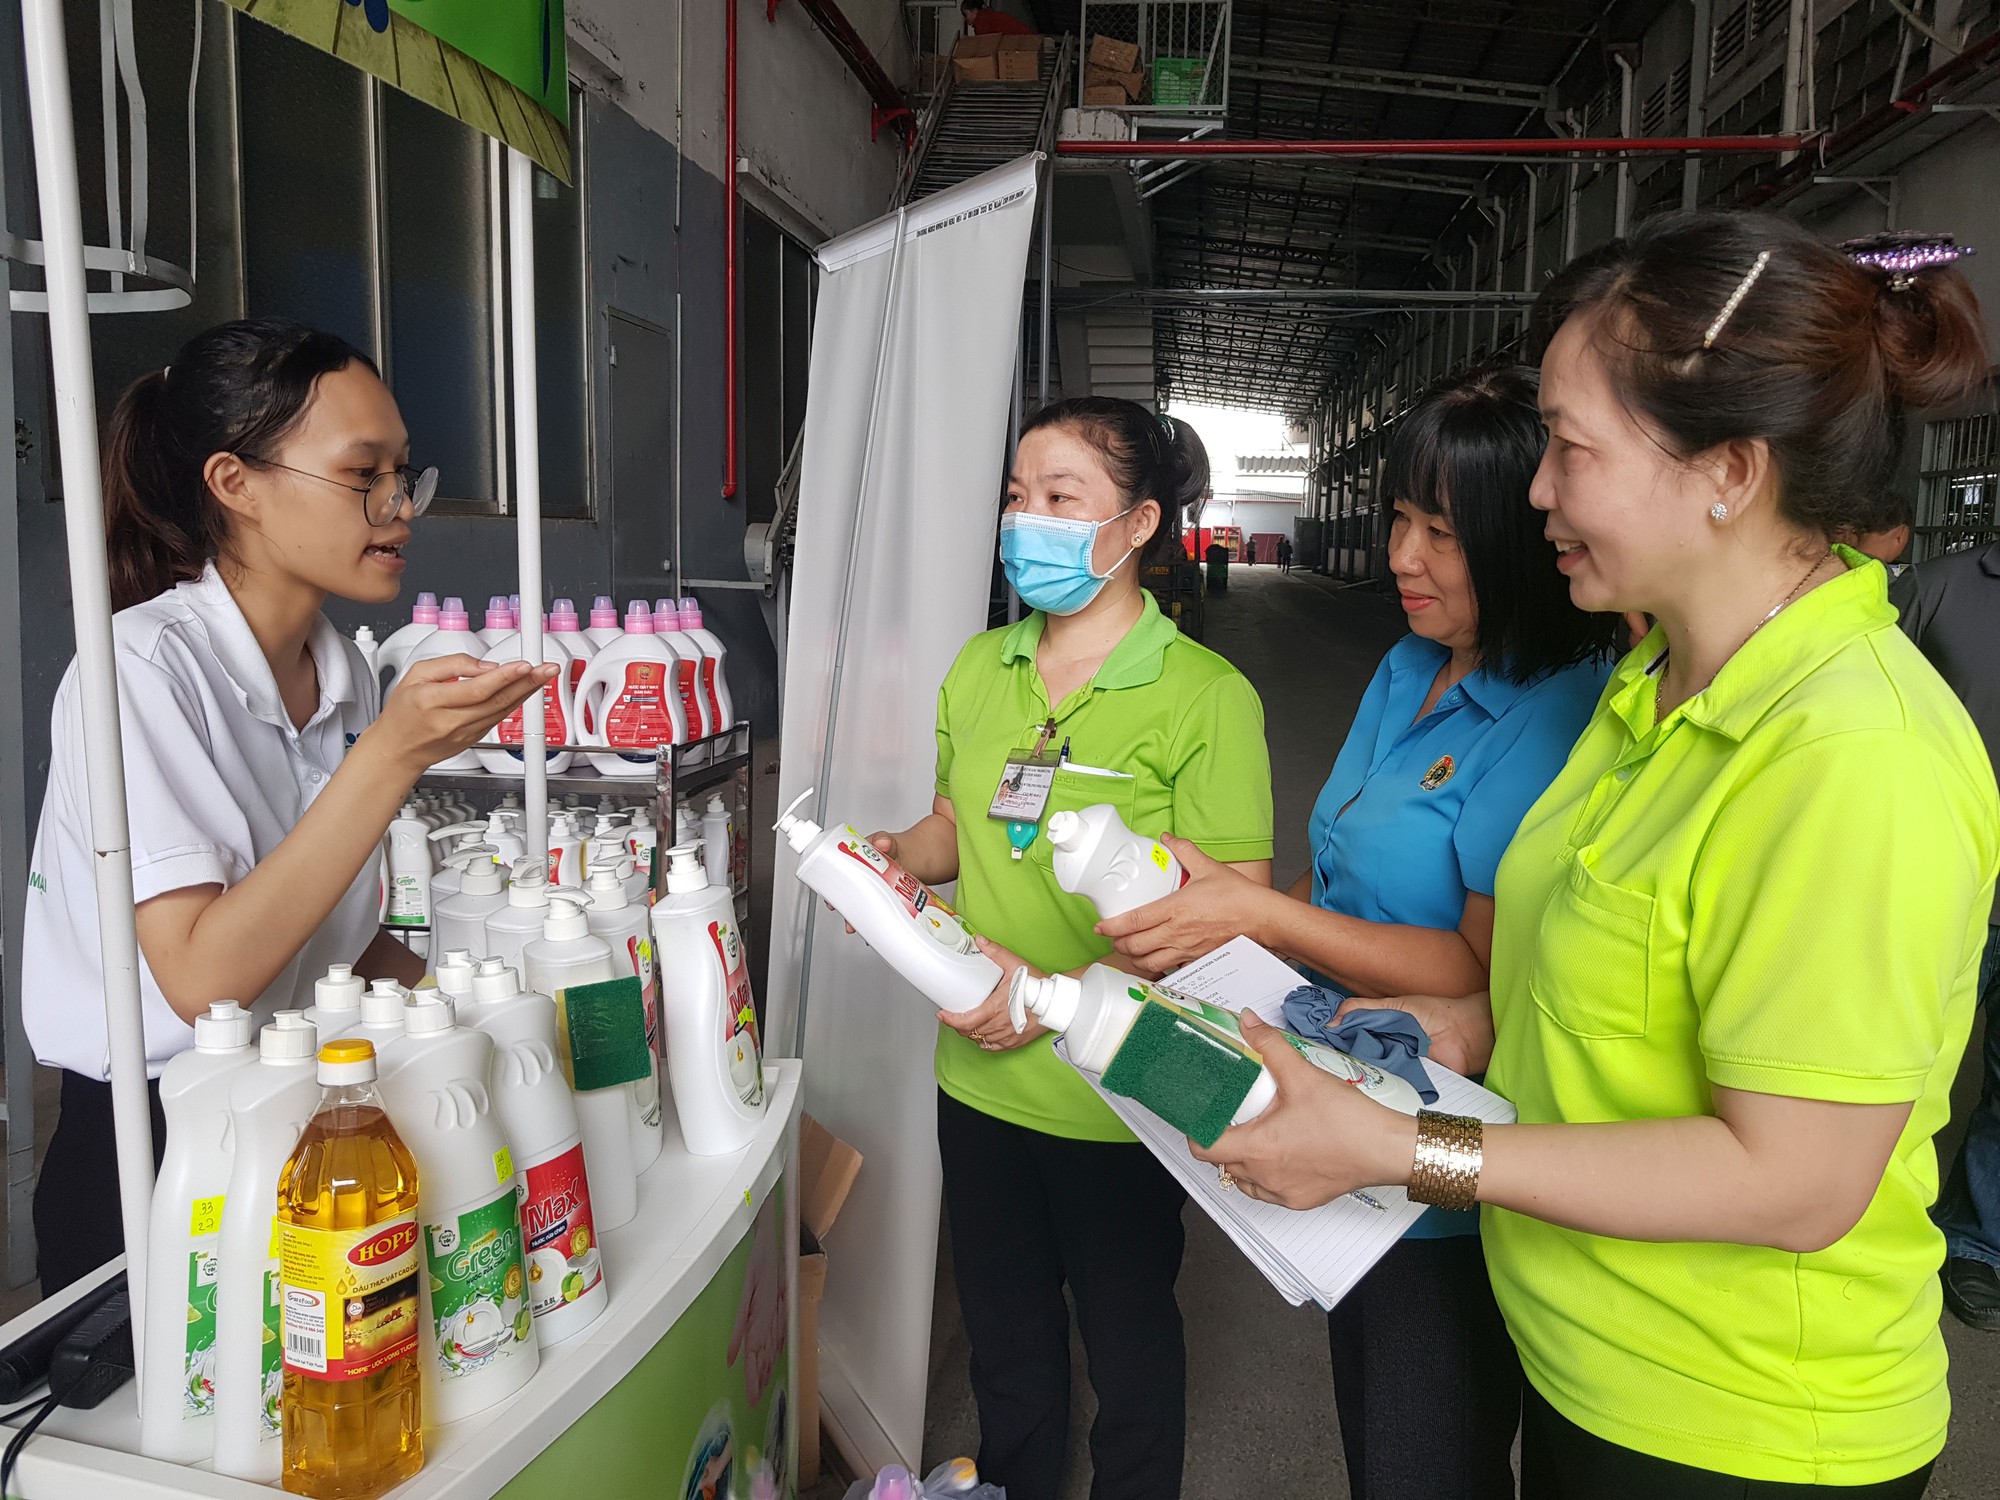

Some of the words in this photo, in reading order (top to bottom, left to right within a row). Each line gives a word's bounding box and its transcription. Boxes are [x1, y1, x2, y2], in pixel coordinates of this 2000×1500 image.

[894, 872, 920, 904] Ma
[728, 979, 750, 1022] Ma
[200, 1202, 214, 1216] 33
[526, 1176, 581, 1237] Max
[358, 1226, 417, 1263] HOPE
[446, 1228, 514, 1282] Green
[398, 1266, 410, 1277] CAO
